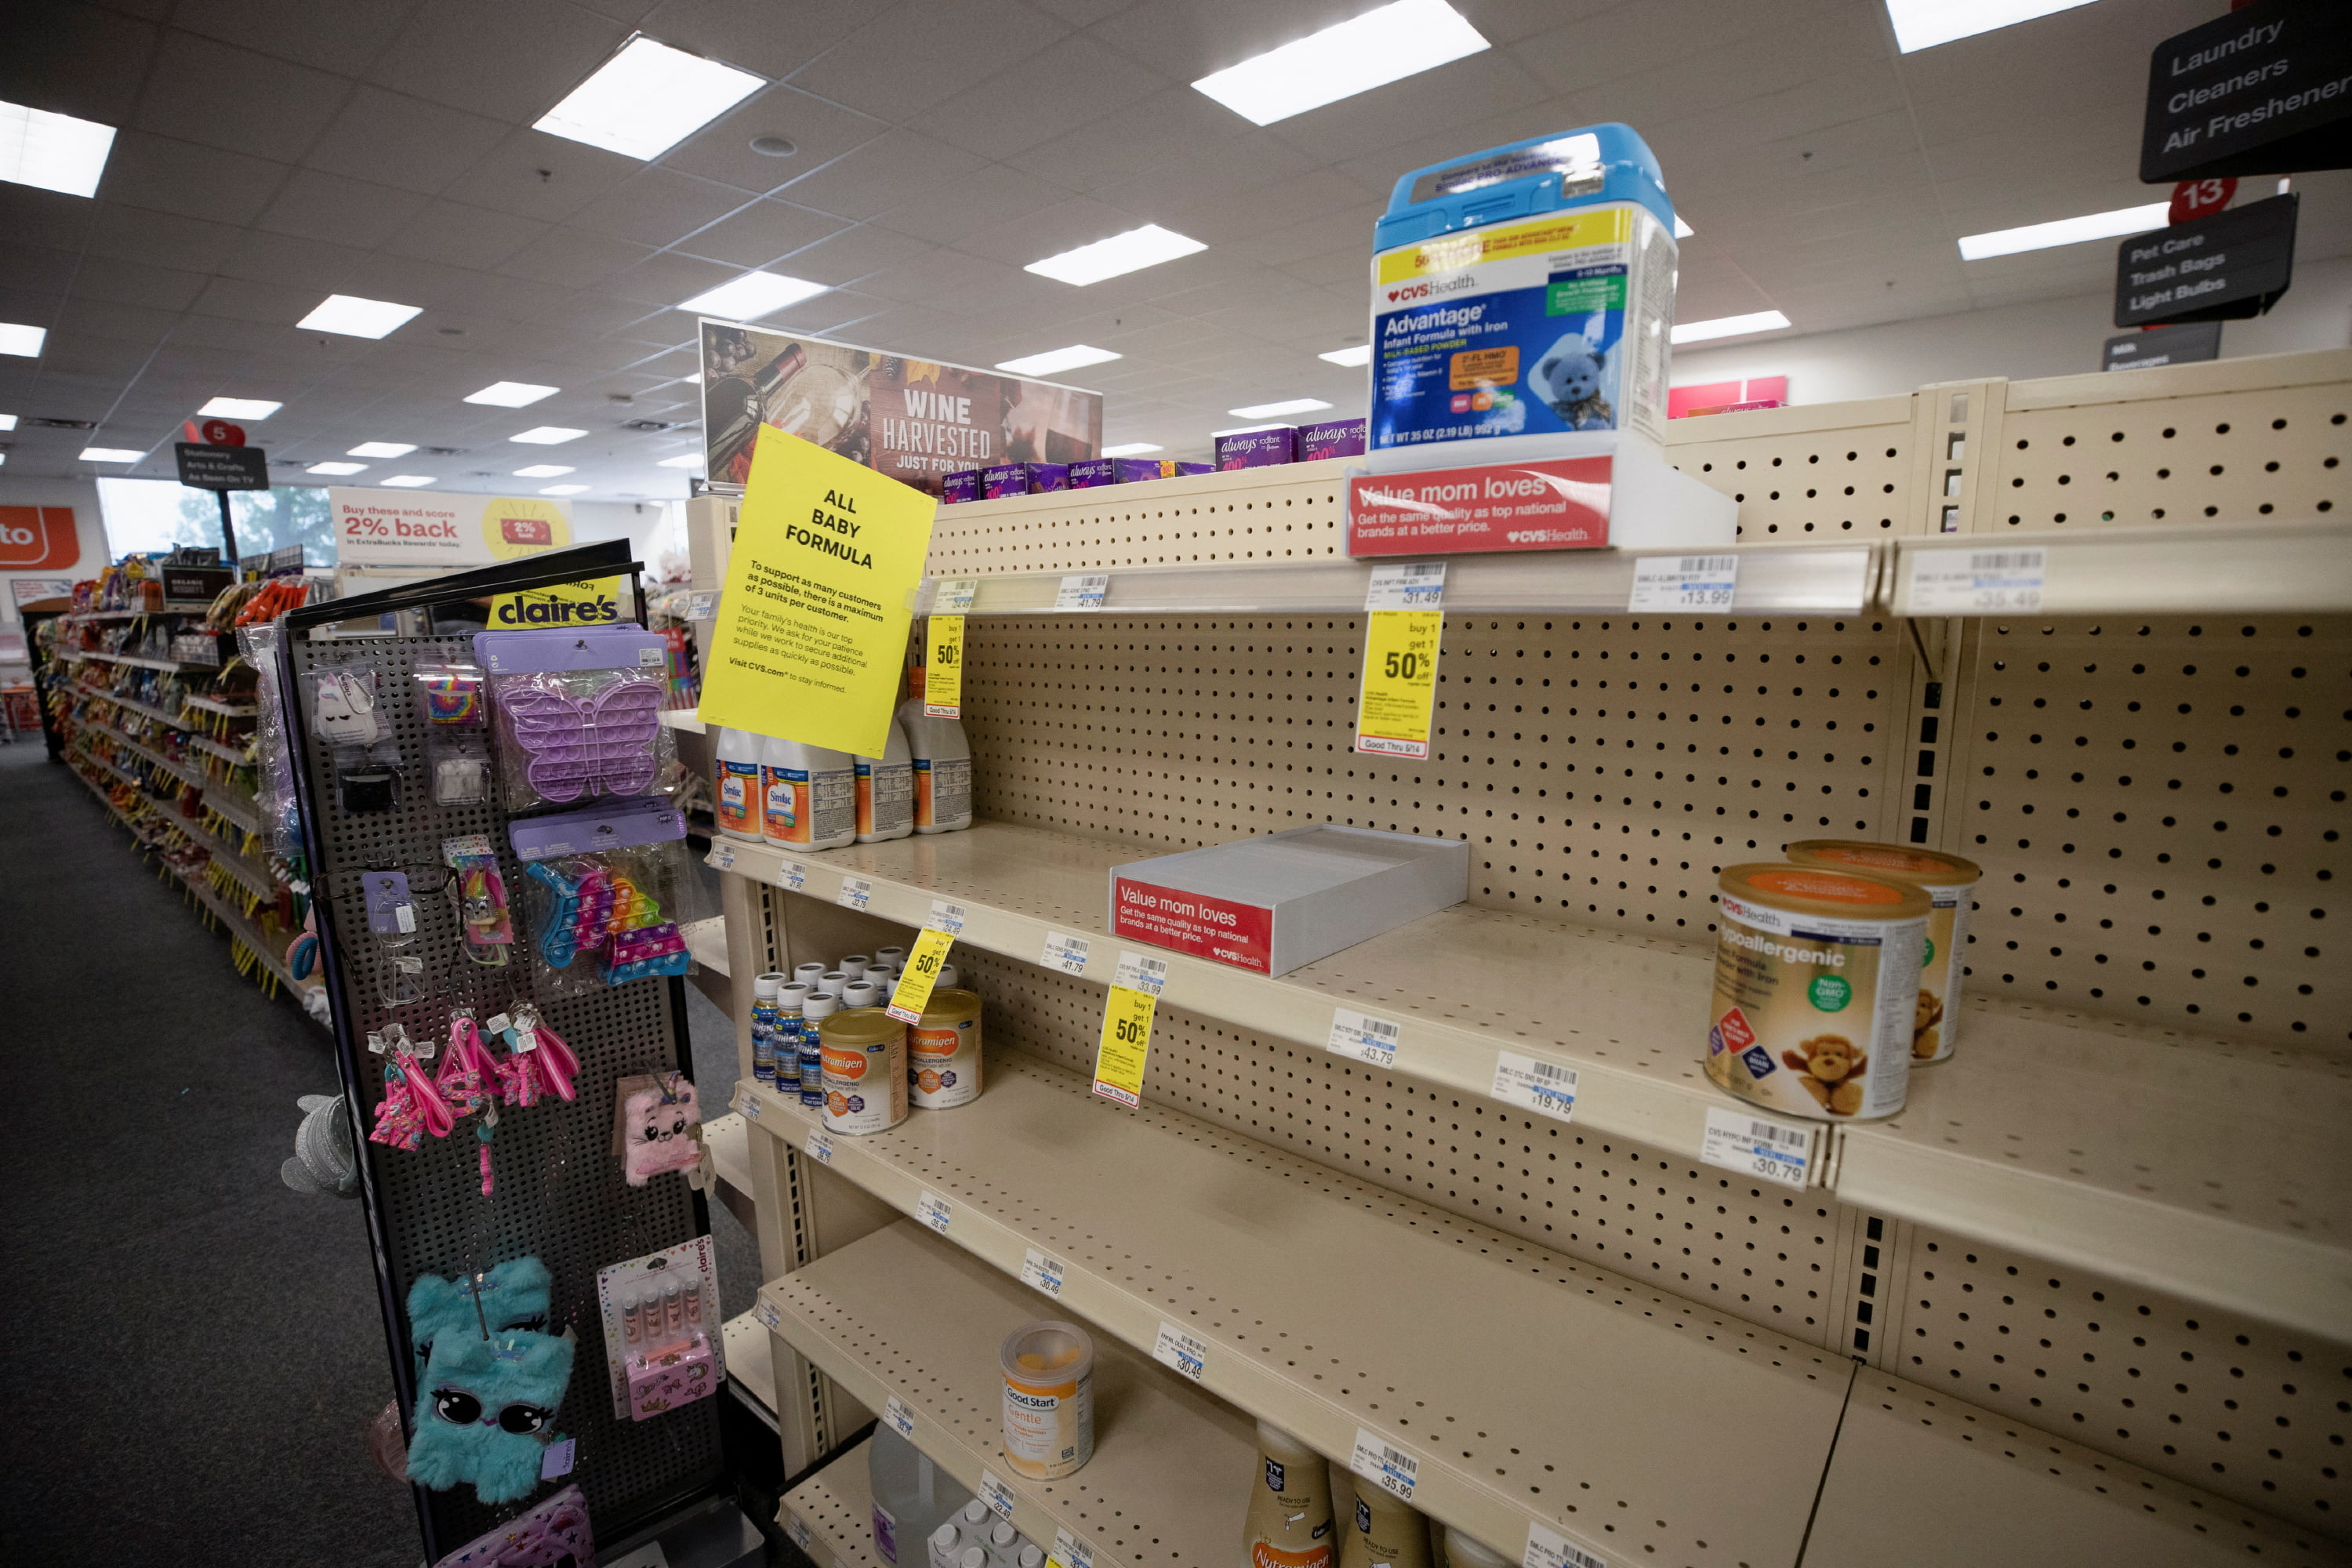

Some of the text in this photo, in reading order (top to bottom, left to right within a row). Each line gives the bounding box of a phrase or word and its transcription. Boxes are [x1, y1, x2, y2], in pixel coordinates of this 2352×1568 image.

[2172, 20, 2285, 77] Laundry
[2167, 56, 2289, 114] Cleaners
[2162, 129, 2201, 154] Air
[2183, 179, 2225, 210] 13
[2131, 234, 2204, 263] Pet Care
[2130, 252, 2225, 287] Trash Bags
[2130, 277, 2225, 312] Light Bulbs
[1384, 320, 1508, 350] Infant Formula with Iron
[904, 388, 971, 425] WINE
[213, 426, 226, 440] 5
[883, 418, 990, 459] HARVESTED
[1306, 426, 1347, 444] always
[1396, 431, 1409, 443] WT
[1410, 430, 1421, 441] 35
[1221, 436, 1280, 454] always radiant
[897, 455, 954, 472] JUST FOR
[1070, 463, 1095, 478] always
[944, 476, 963, 488] always
[984, 466, 1008, 484] always
[824, 489, 857, 514] ALL
[1359, 477, 1547, 507] Value mom loves
[342, 505, 365, 516] Buy
[368, 506, 398, 515] these
[401, 507, 423, 517] and
[1358, 500, 1566, 524] Get the same as top national
[344, 517, 458, 539] 2% back
[514, 521, 535, 532] 2%
[811, 508, 861, 538] BABY
[1358, 521, 1490, 538] brands at better price.
[786, 524, 873, 569] FORMULA
[764, 566, 882, 611] support many customers
[498, 594, 618, 624] claire's
[765, 590, 805, 608] units per
[804, 590, 884, 622] there maximum
[741, 604, 853, 644] Your health our top
[1410, 623, 1436, 635] buy 1
[733, 636, 809, 664] supplies quickly
[736, 626, 867, 668] while work secure additional
[786, 628, 863, 657] ask for your patience
[1409, 640, 1433, 651] get 1
[729, 657, 813, 686] Visit stay
[1365, 739, 1403, 752] Good Thru
[724, 784, 742, 797] Similac
[770, 790, 791, 804] Similac
[1121, 885, 1237, 927] Value mom loves
[1120, 906, 1133, 916] Get
[1134, 909, 1145, 919] the
[1146, 913, 1166, 924] same
[1167, 917, 1191, 931] quality
[1203, 926, 1216, 937] top
[1218, 930, 1249, 944] national
[1120, 915, 1144, 928] brands
[1160, 925, 1181, 937] better
[1182, 931, 1203, 943] price.
[935, 938, 945, 947] buy
[1062, 960, 1083, 972] $41.79
[1138, 982, 1161, 995] $33.99
[1134, 1000, 1146, 1011] buy
[1133, 1014, 1144, 1022] get
[1361, 1047, 1392, 1064] $43.79
[1749, 1056, 1769, 1069] BRAIN
[1099, 1085, 1123, 1098] Good Thru
[1532, 1094, 1572, 1114] $19.79
[1753, 1158, 1802, 1182] $30.79
[696, 1238, 705, 1273] claire's
[1175, 1341, 1185, 1350] DUAL
[1177, 1359, 1201, 1379] $30.49
[1007, 1388, 1055, 1407] Good Start
[1009, 1404, 1041, 1425] Gentle
[1356, 1444, 1368, 1455] SMLC
[1382, 1475, 1411, 1498] $35.99
[1363, 1537, 1381, 1551] READY
[1530, 1541, 1555, 1559] SMLC PRO
